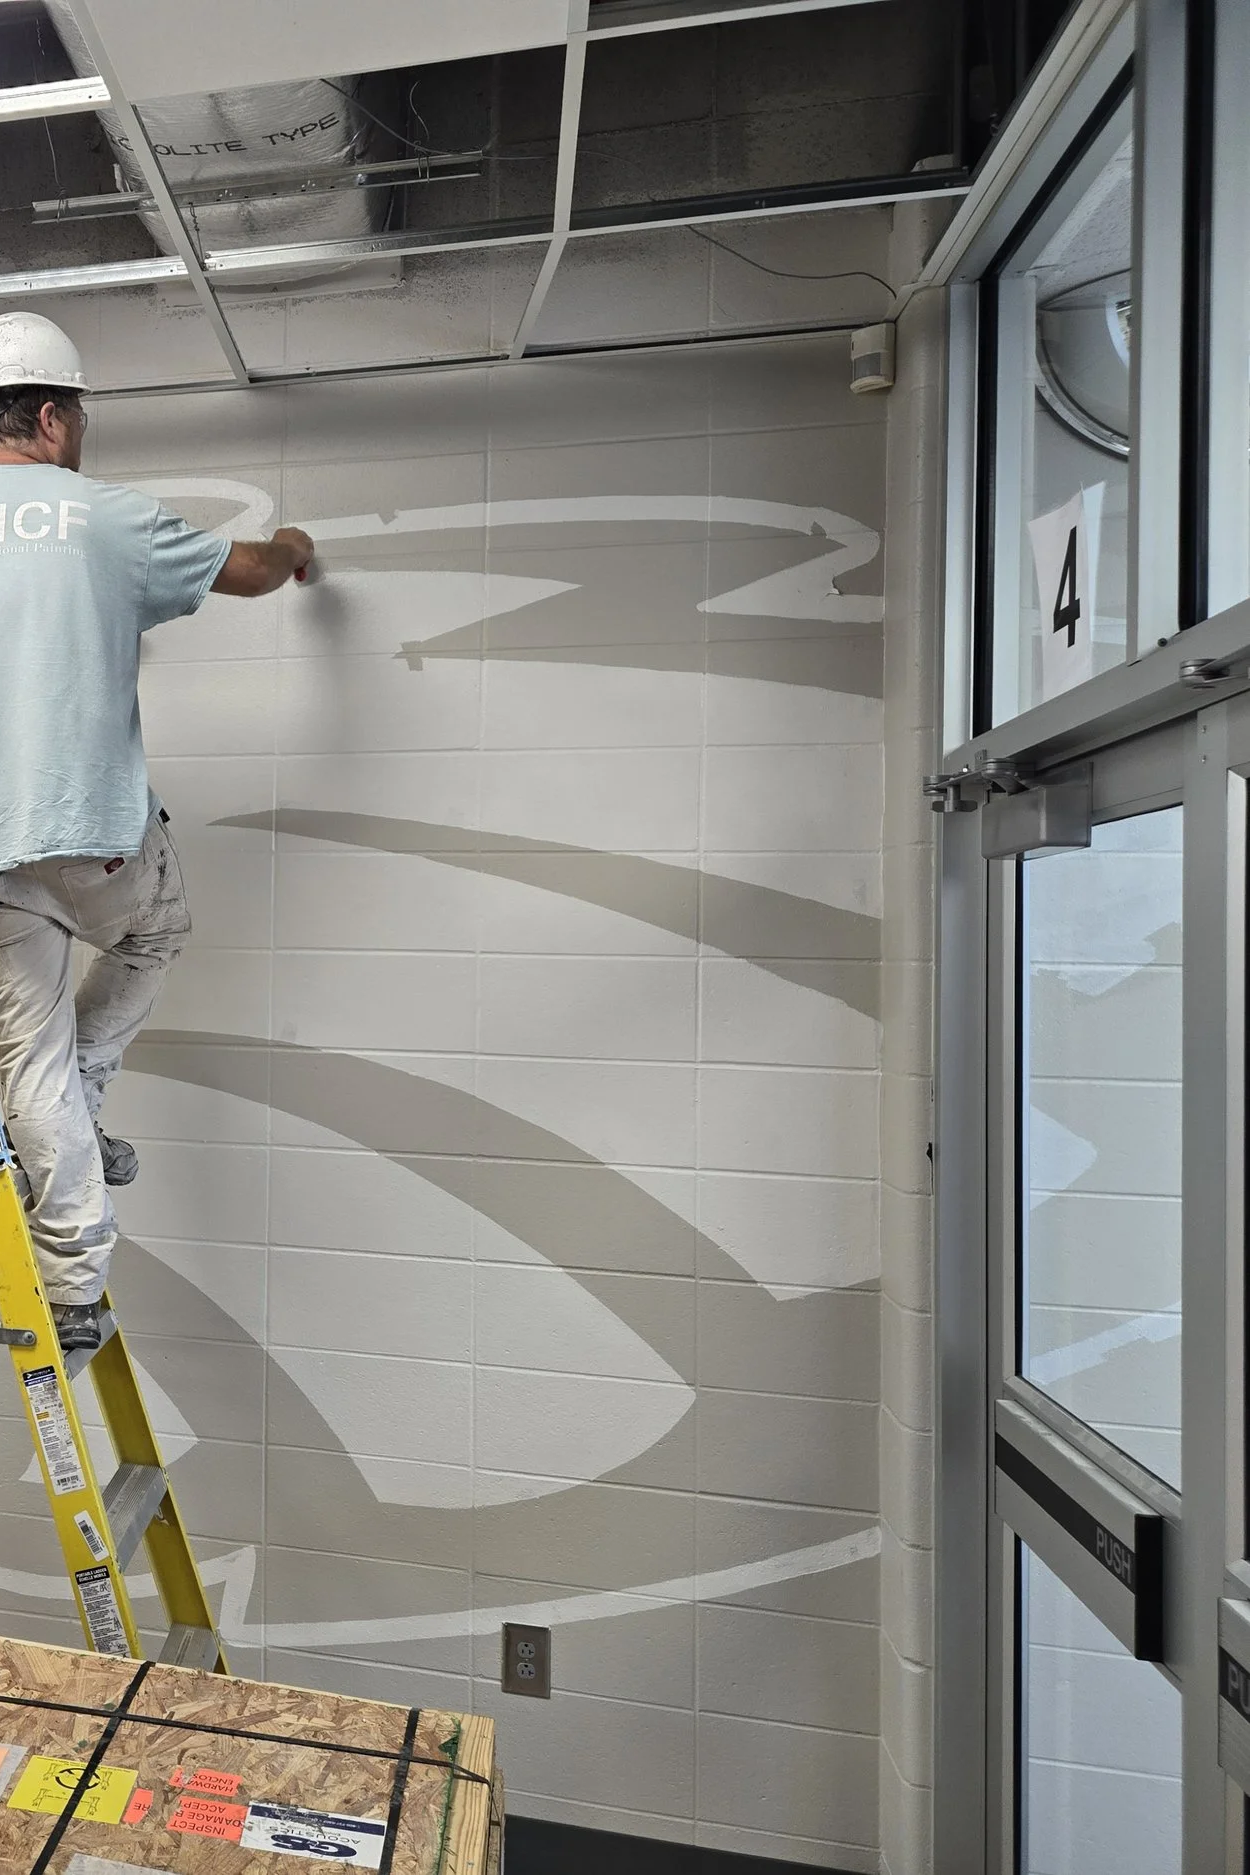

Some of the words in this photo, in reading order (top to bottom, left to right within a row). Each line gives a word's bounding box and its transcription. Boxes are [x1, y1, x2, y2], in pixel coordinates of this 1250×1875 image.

[262, 111, 340, 145] TYPE
[34, 542, 87, 560] Painting
[1052, 525, 1081, 648] 4
[1095, 1526, 1134, 1584] PUSH
[170, 1819, 226, 1836] INSPECT
[187, 1812, 241, 1828] DAMAGE
[266, 1825, 361, 1845] ACOUSTICS
